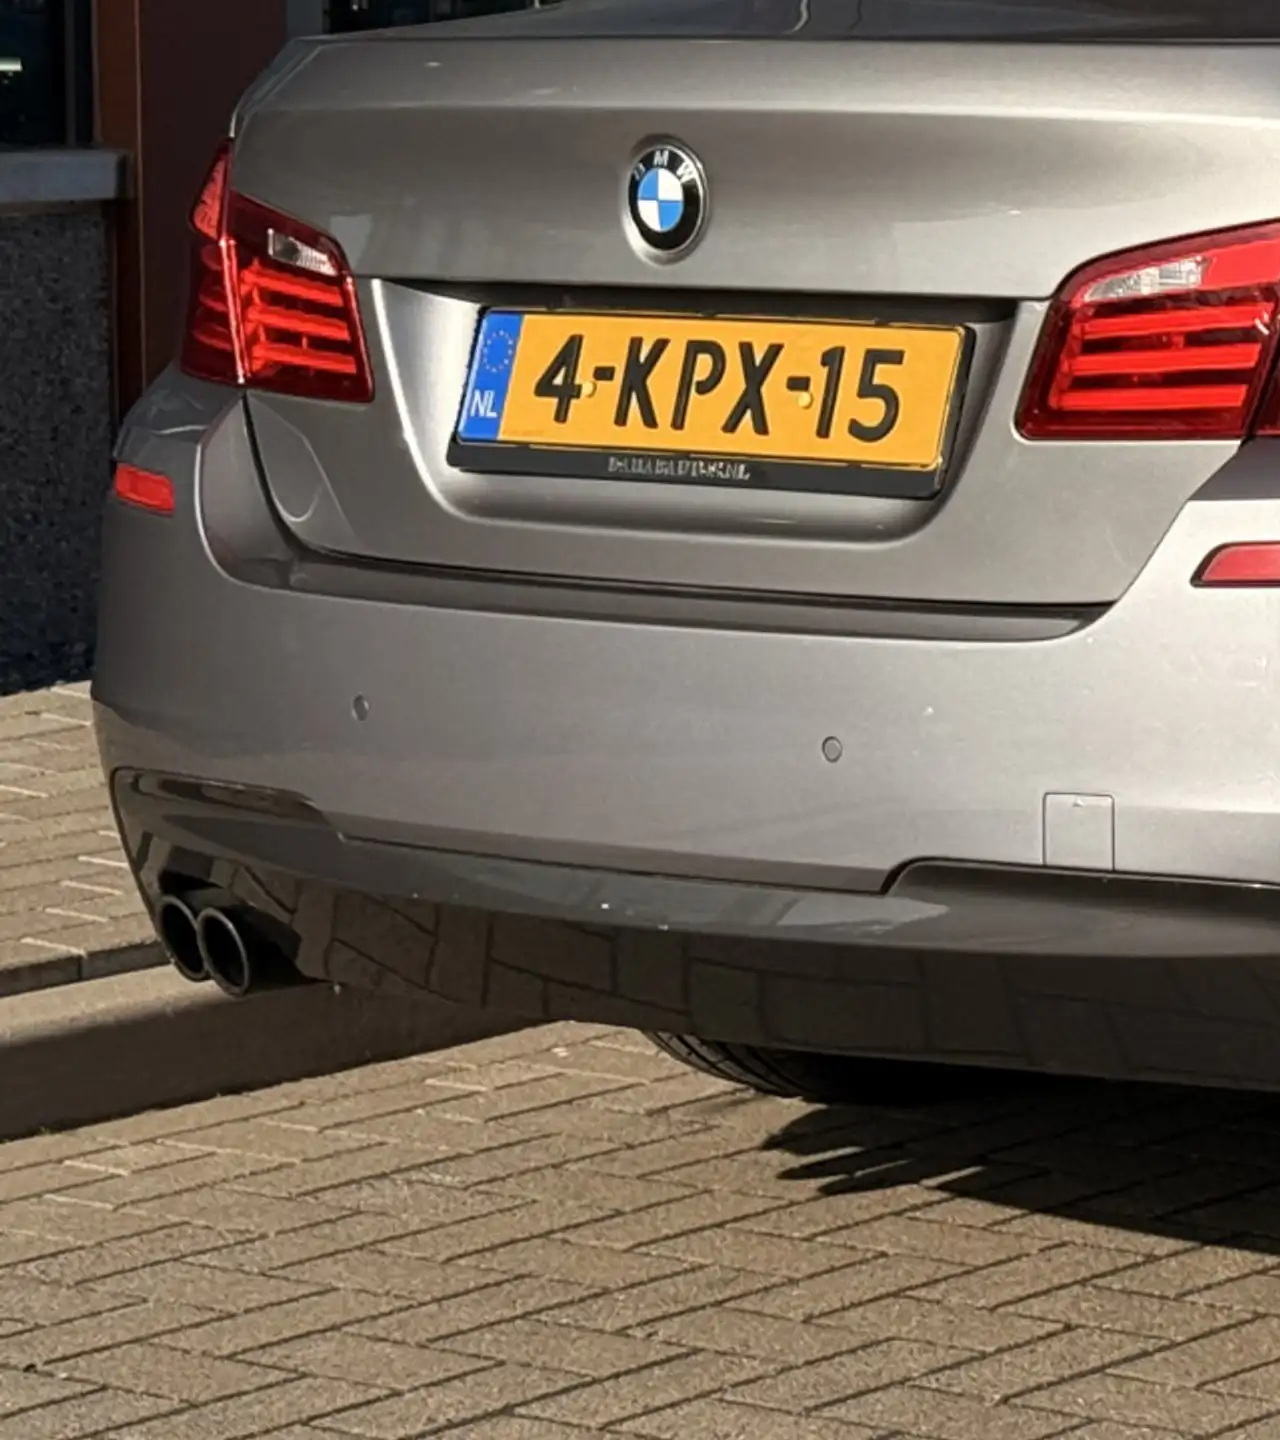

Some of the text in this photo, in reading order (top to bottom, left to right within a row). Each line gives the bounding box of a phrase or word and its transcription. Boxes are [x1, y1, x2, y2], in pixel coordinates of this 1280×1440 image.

[633, 148, 699, 185] BMW
[470, 389, 498, 418] NL
[534, 333, 907, 442] 4-KPX-15
